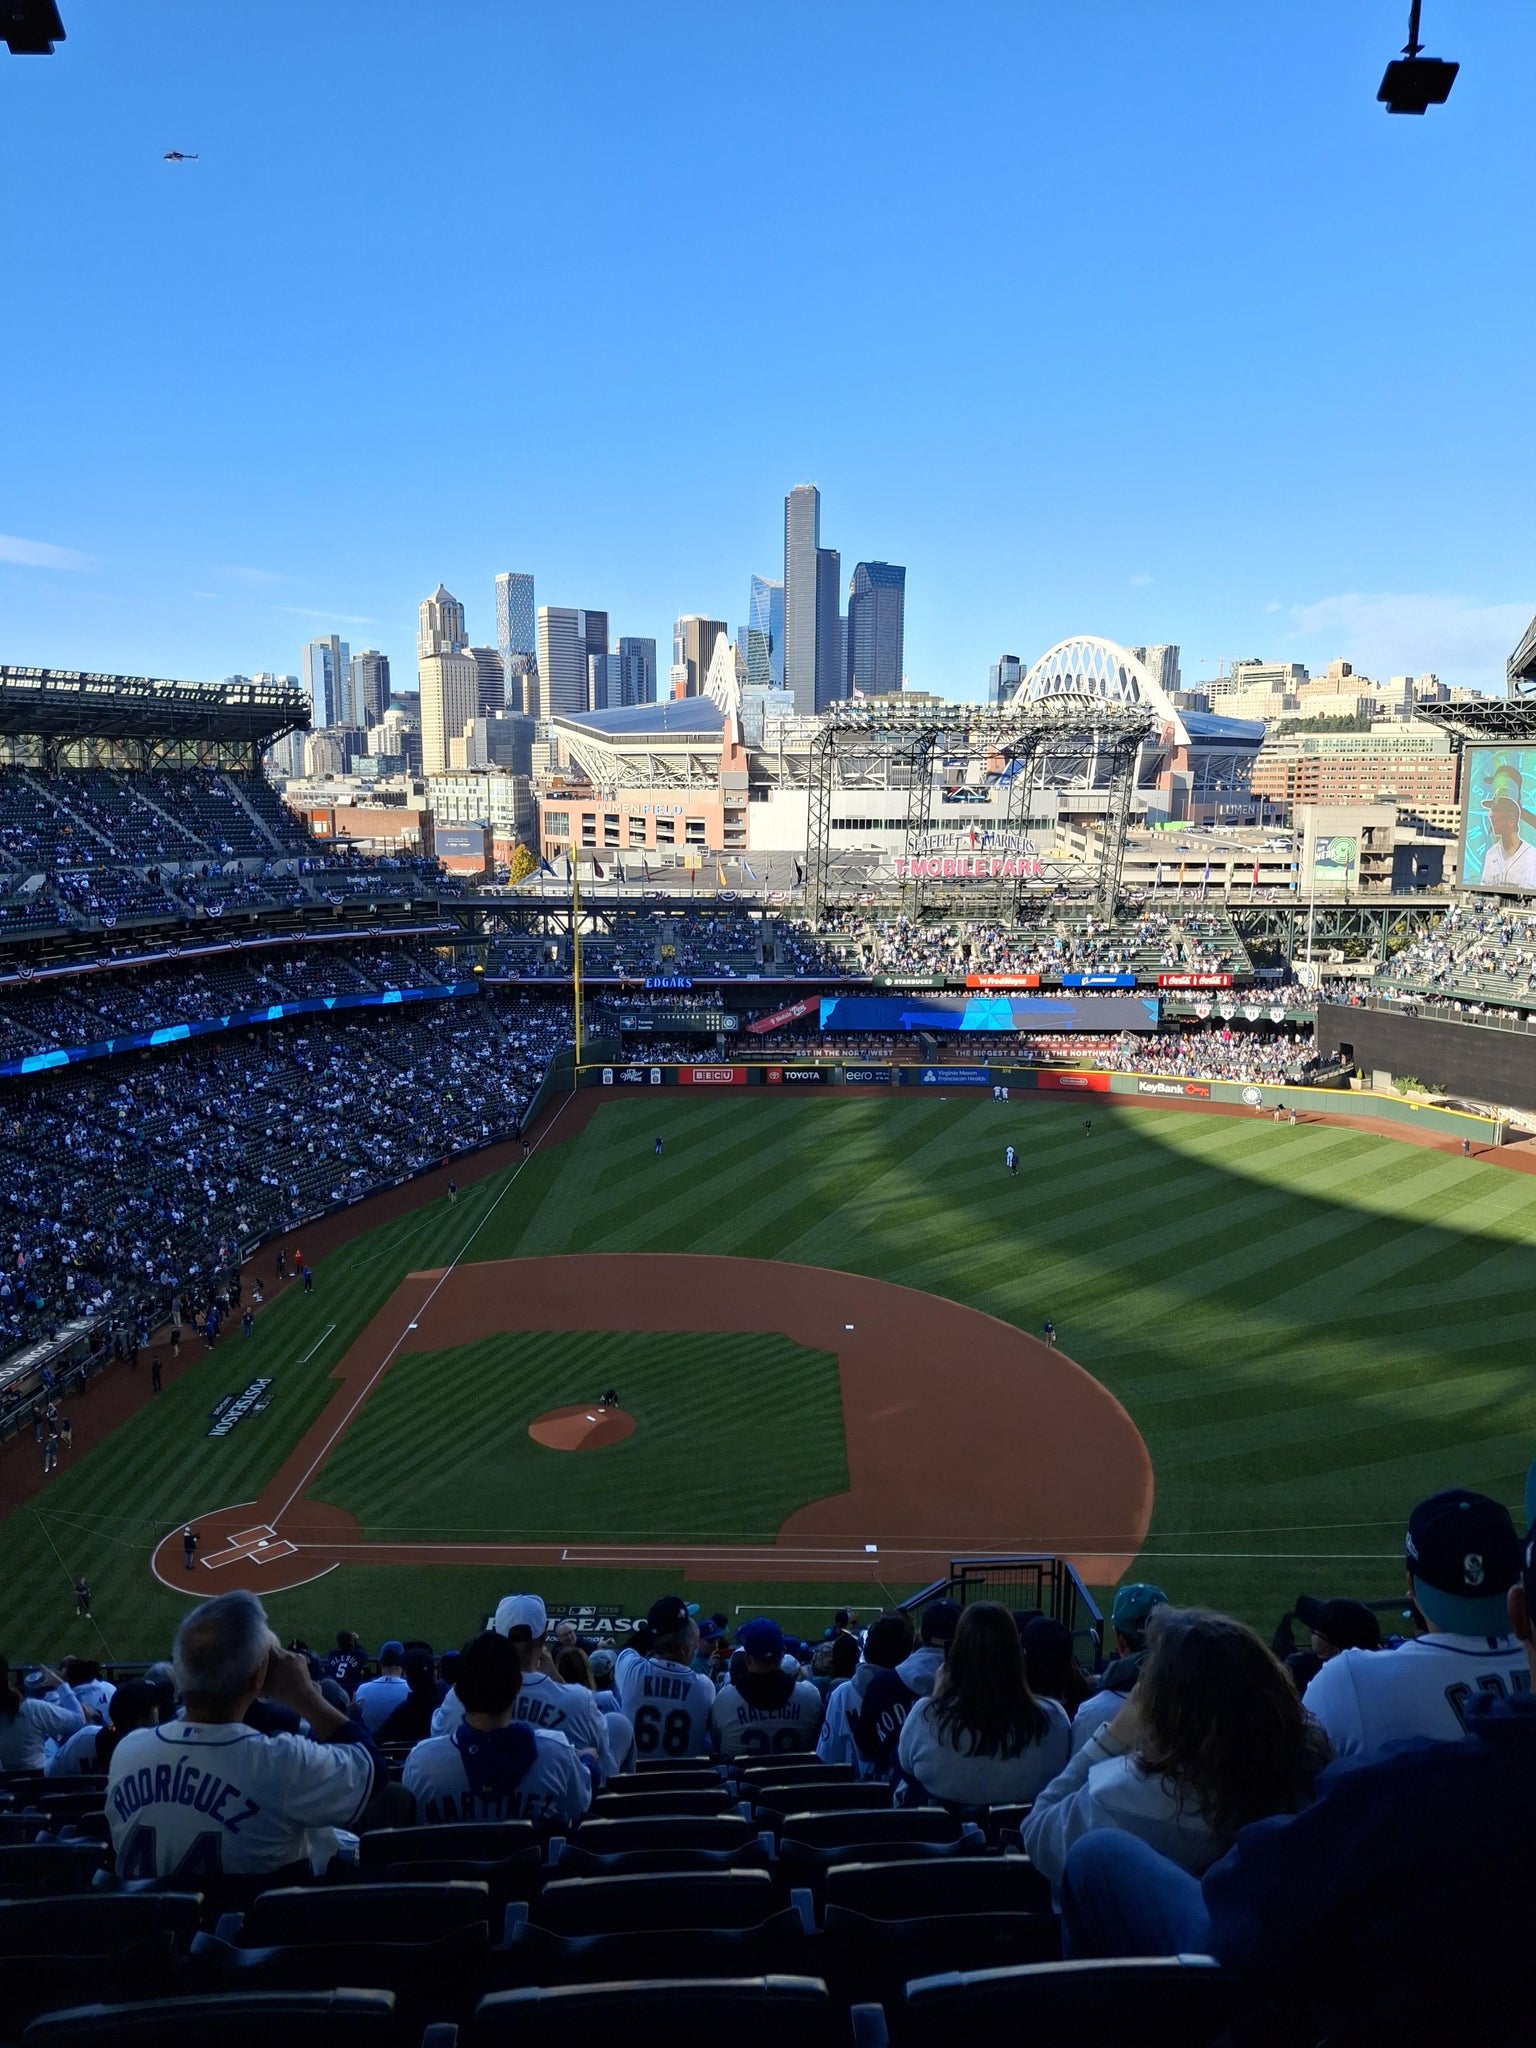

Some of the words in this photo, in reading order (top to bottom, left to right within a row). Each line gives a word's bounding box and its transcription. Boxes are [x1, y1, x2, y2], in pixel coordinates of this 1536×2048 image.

[596, 802, 641, 814] LUMEN
[643, 803, 683, 815] FIELD
[1220, 804, 1255, 815] LUMEN
[1256, 804, 1277, 814] FELD
[908, 833, 956, 852] SEATTLE
[983, 830, 1035, 852] MARINERS
[894, 859, 986, 877] T-MOBILE
[991, 859, 1044, 876] PARK
[846, 1071, 873, 1080] eero
[1139, 1081, 1184, 1094] KeyBank
[208, 1378, 272, 1436] POSTSEASON
[335, 1662, 348, 1678] 5
[643, 1675, 692, 1702] KIRBY
[634, 1704, 692, 1756] 68
[113, 1755, 260, 1835] RODRÍGUEZ
